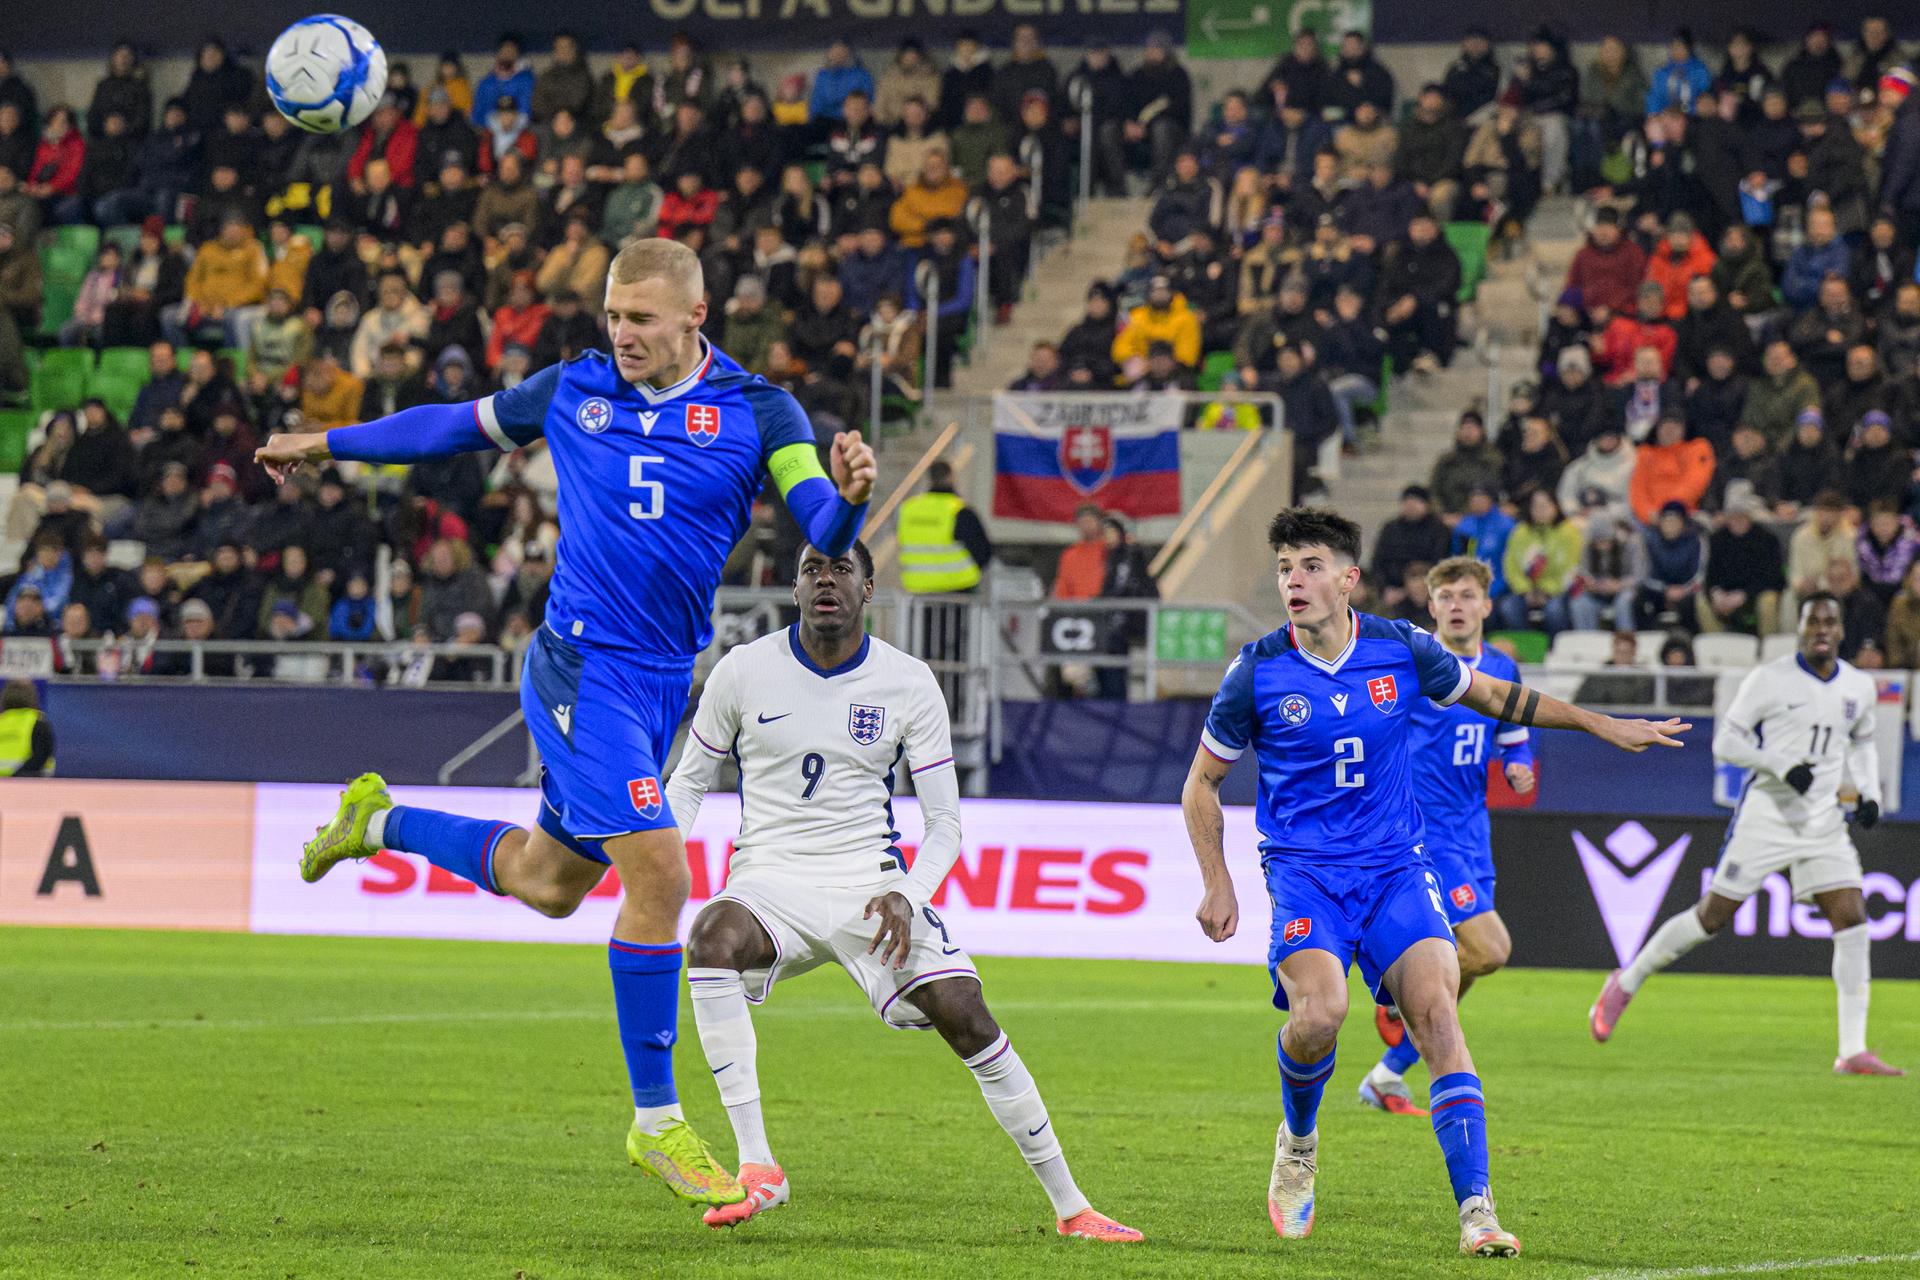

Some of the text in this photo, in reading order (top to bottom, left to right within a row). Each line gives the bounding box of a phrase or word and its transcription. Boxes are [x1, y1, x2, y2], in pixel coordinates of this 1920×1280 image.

[629, 455, 665, 519] 5
[1051, 616, 1096, 651] C2
[1334, 736, 1365, 788] 2
[1453, 723, 1486, 766] 21
[1810, 724, 1832, 755] 11
[801, 752, 826, 801] 9
[36, 814, 102, 898] A
[922, 906, 950, 944] 9
